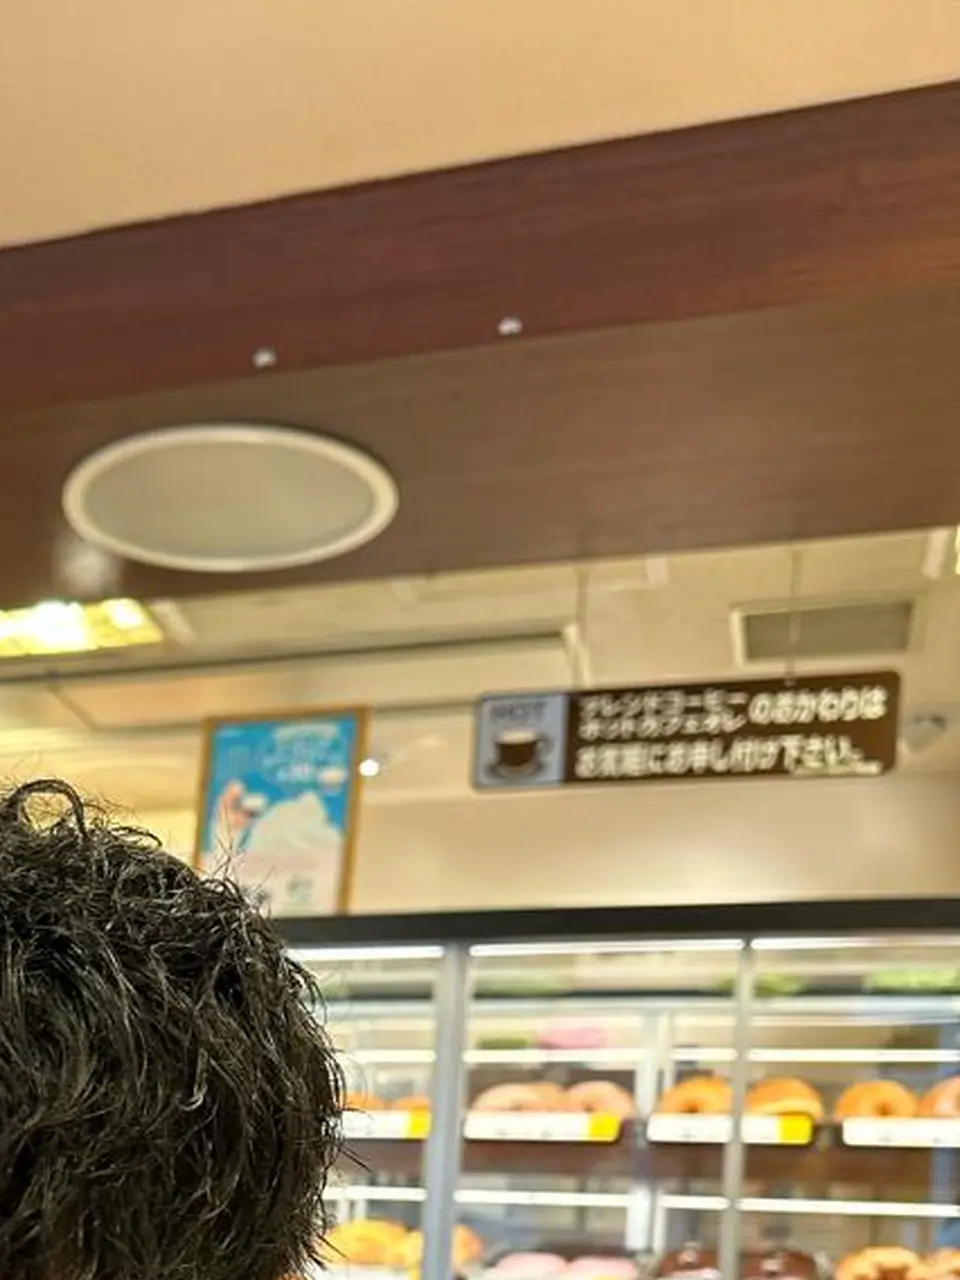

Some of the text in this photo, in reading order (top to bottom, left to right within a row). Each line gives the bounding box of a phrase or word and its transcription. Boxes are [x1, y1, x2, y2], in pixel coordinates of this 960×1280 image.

[749, 685, 887, 724] のおかわりは
